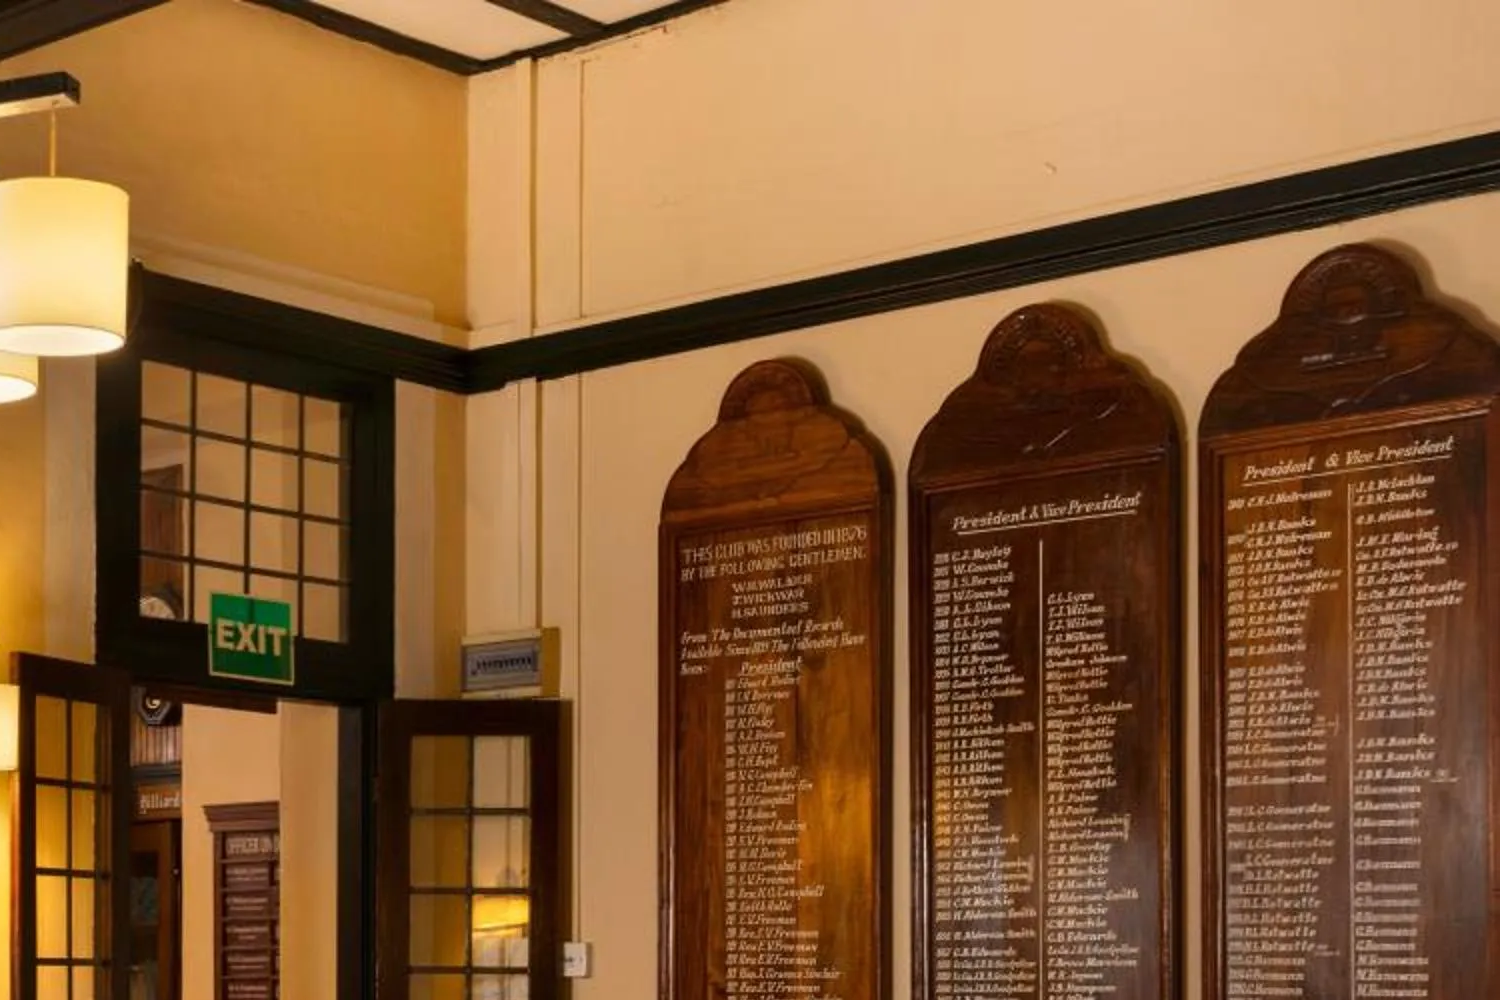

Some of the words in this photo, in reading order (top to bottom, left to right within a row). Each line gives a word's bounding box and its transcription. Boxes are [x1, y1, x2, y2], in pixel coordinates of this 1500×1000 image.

[1243, 457, 1315, 481] President
[1345, 450, 1374, 466] Vice
[1377, 435, 1454, 462] President
[952, 506, 1027, 530] President
[1041, 502, 1067, 519] Vice
[1068, 491, 1143, 516] President
[216, 618, 287, 657] EXIT
